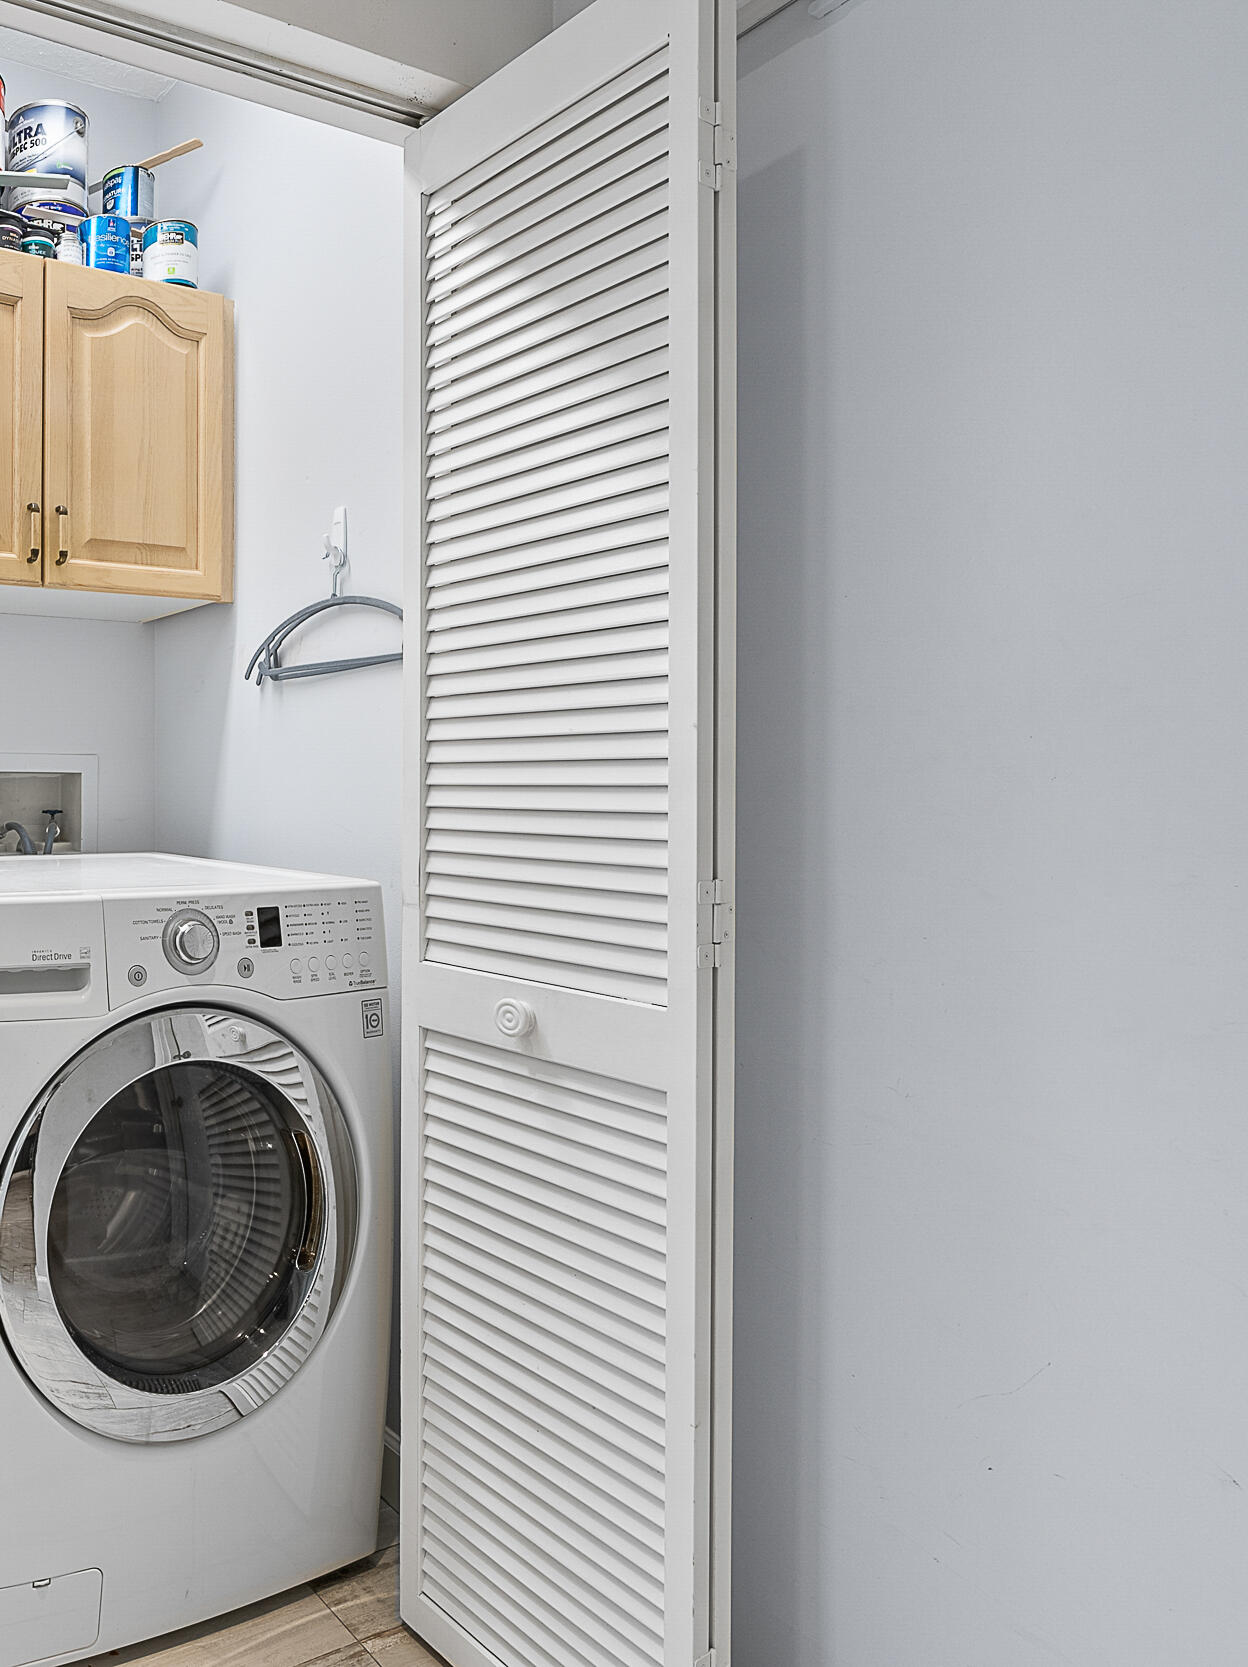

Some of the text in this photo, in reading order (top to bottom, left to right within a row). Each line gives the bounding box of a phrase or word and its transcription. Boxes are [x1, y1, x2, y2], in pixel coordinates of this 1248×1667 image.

[9, 123, 47, 152] LTRA
[11, 137, 47, 160] SPEC 500
[89, 233, 130, 248] esilience
